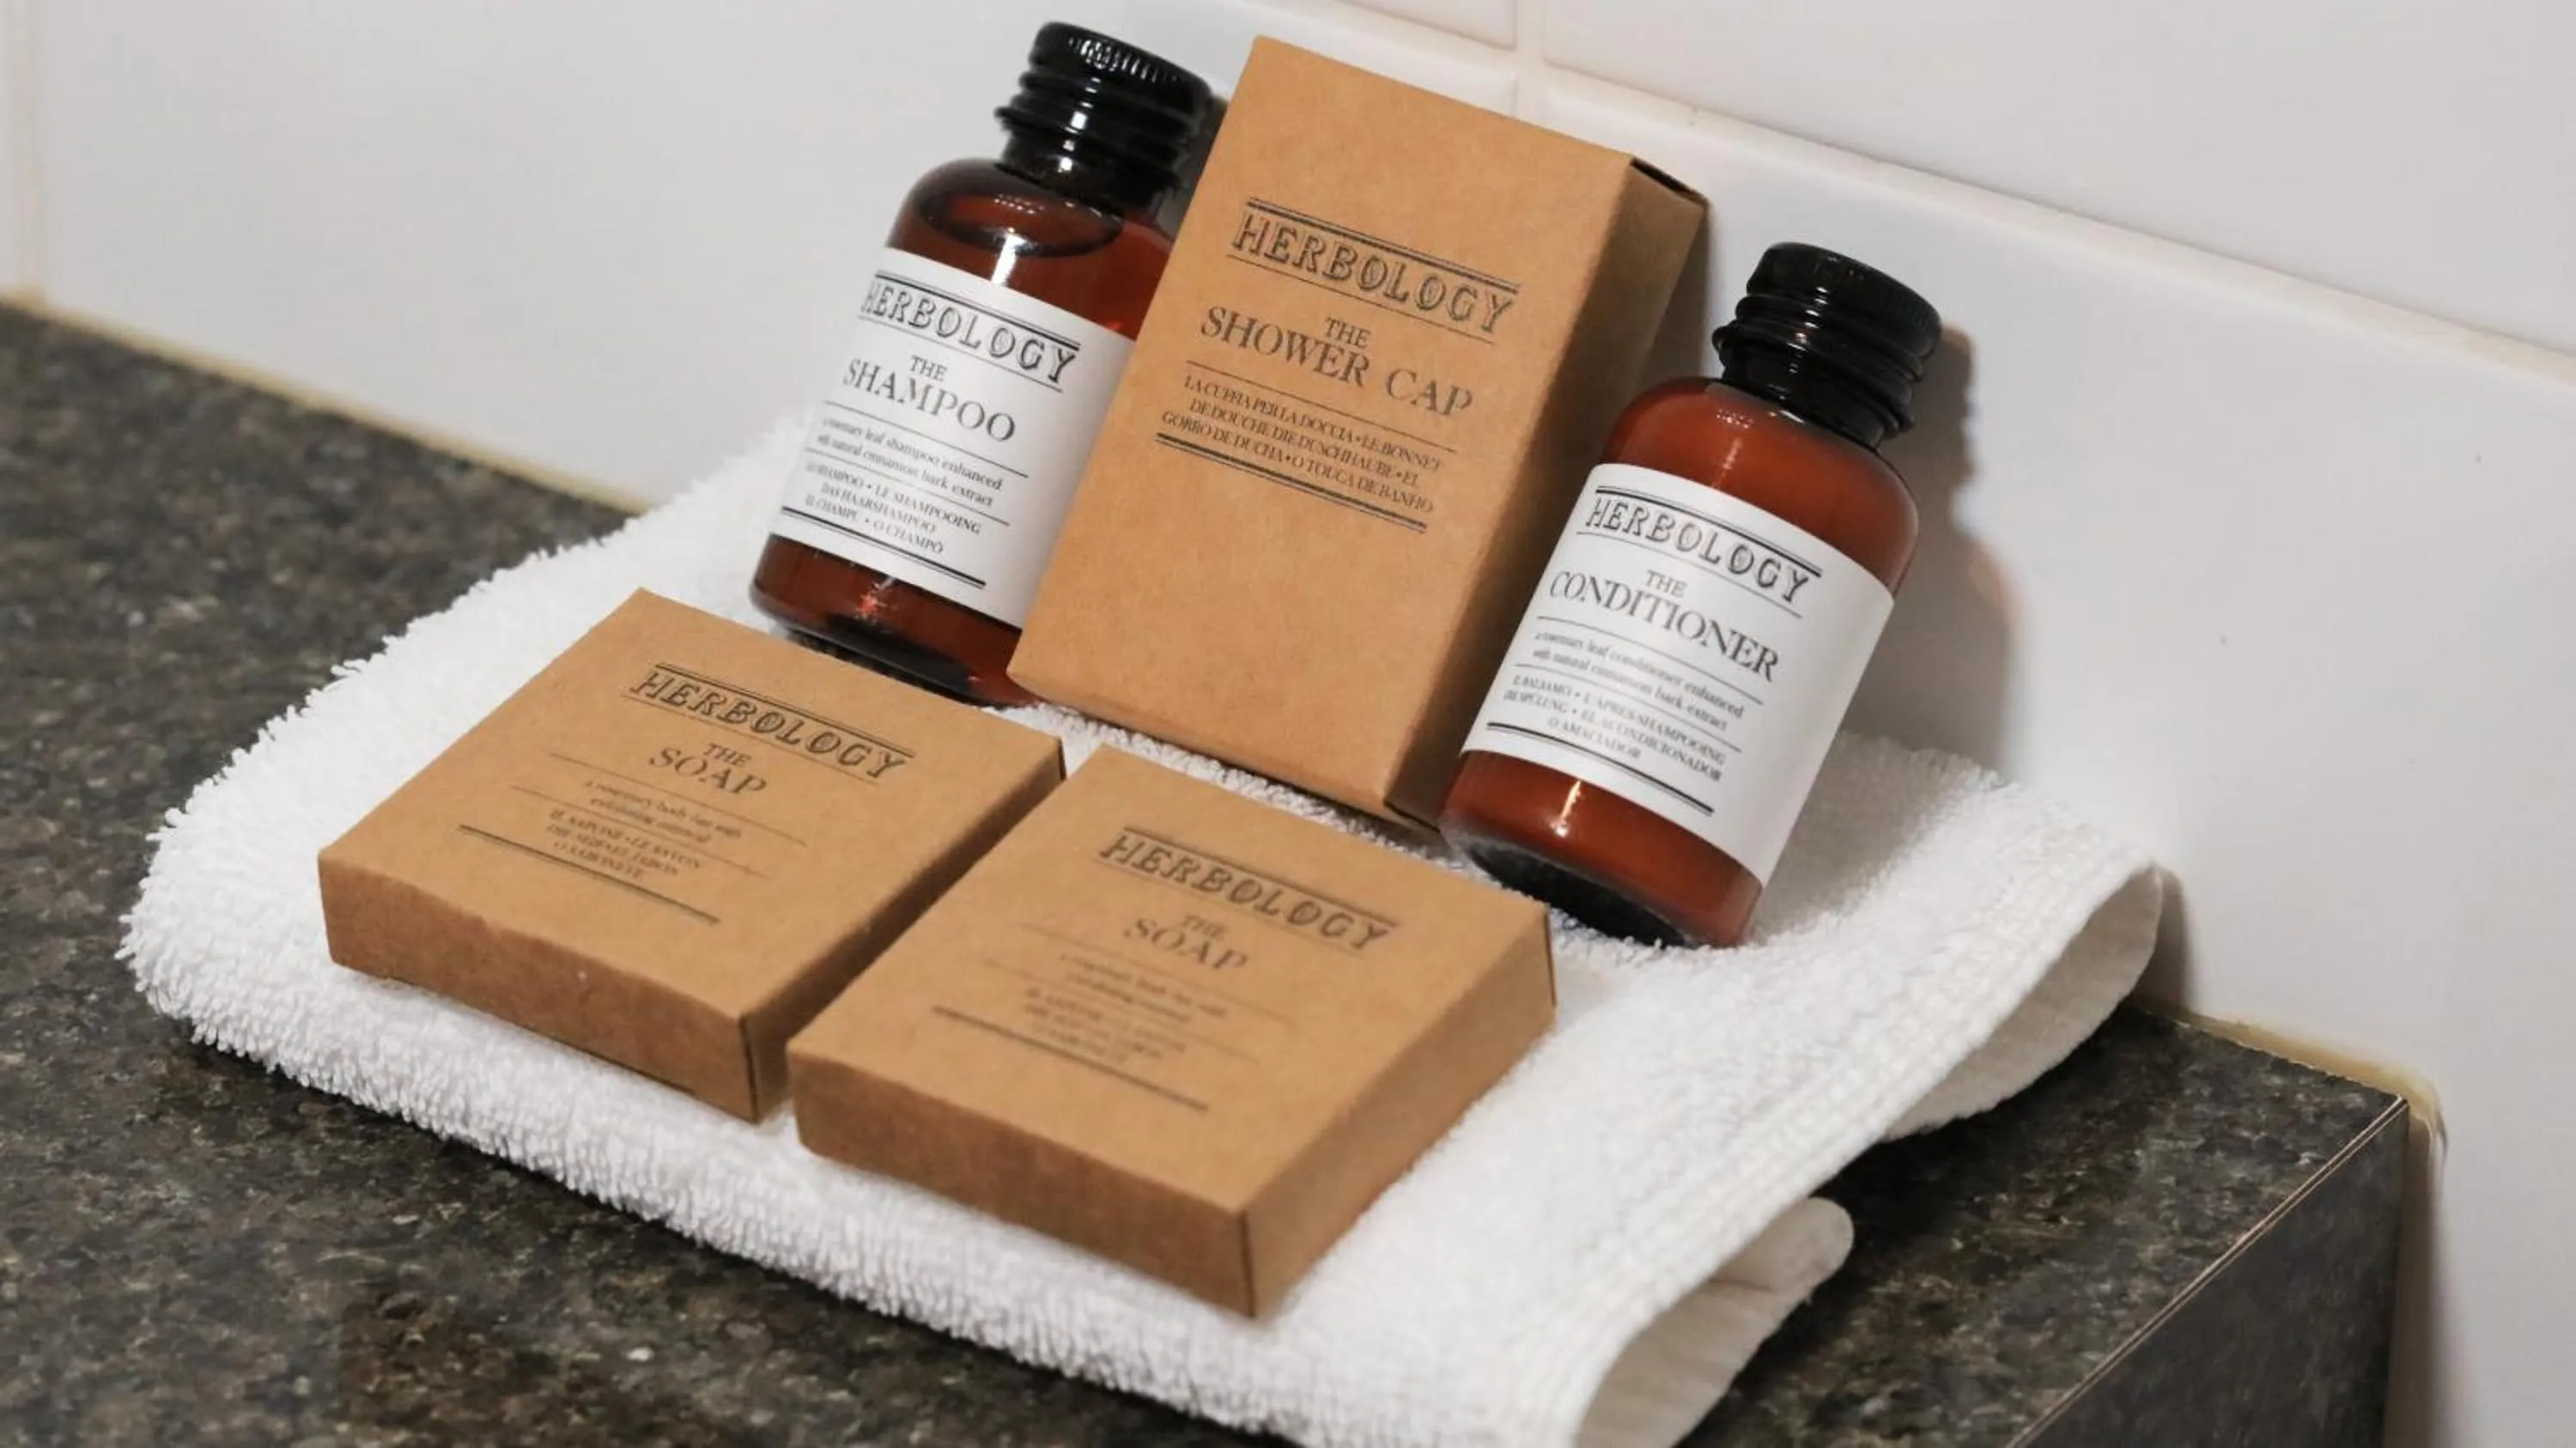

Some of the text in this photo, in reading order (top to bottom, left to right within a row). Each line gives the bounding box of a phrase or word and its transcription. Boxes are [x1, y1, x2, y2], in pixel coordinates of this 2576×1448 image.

[1231, 211, 1514, 333] HERBOLOGY
[860, 280, 1076, 383] HERBOLOGY
[1200, 305, 1473, 417] SHOWER CAP
[1324, 316, 1371, 349] THE
[842, 357, 1016, 441] SHAMPOO
[910, 355, 947, 382] THE
[942, 459, 1003, 490] enhanced
[1585, 496, 1809, 603] HERBOLOGY
[1645, 569, 1688, 599] THE
[1549, 570, 1778, 682] CONDITIONER
[630, 672, 907, 779] HERBOLOGY
[702, 743, 751, 767] THE
[649, 746, 768, 794] SOAP
[1098, 835, 1389, 950] HERBOLOGY
[1123, 917, 1249, 969] SOAP
[1181, 914, 1229, 940] THE
